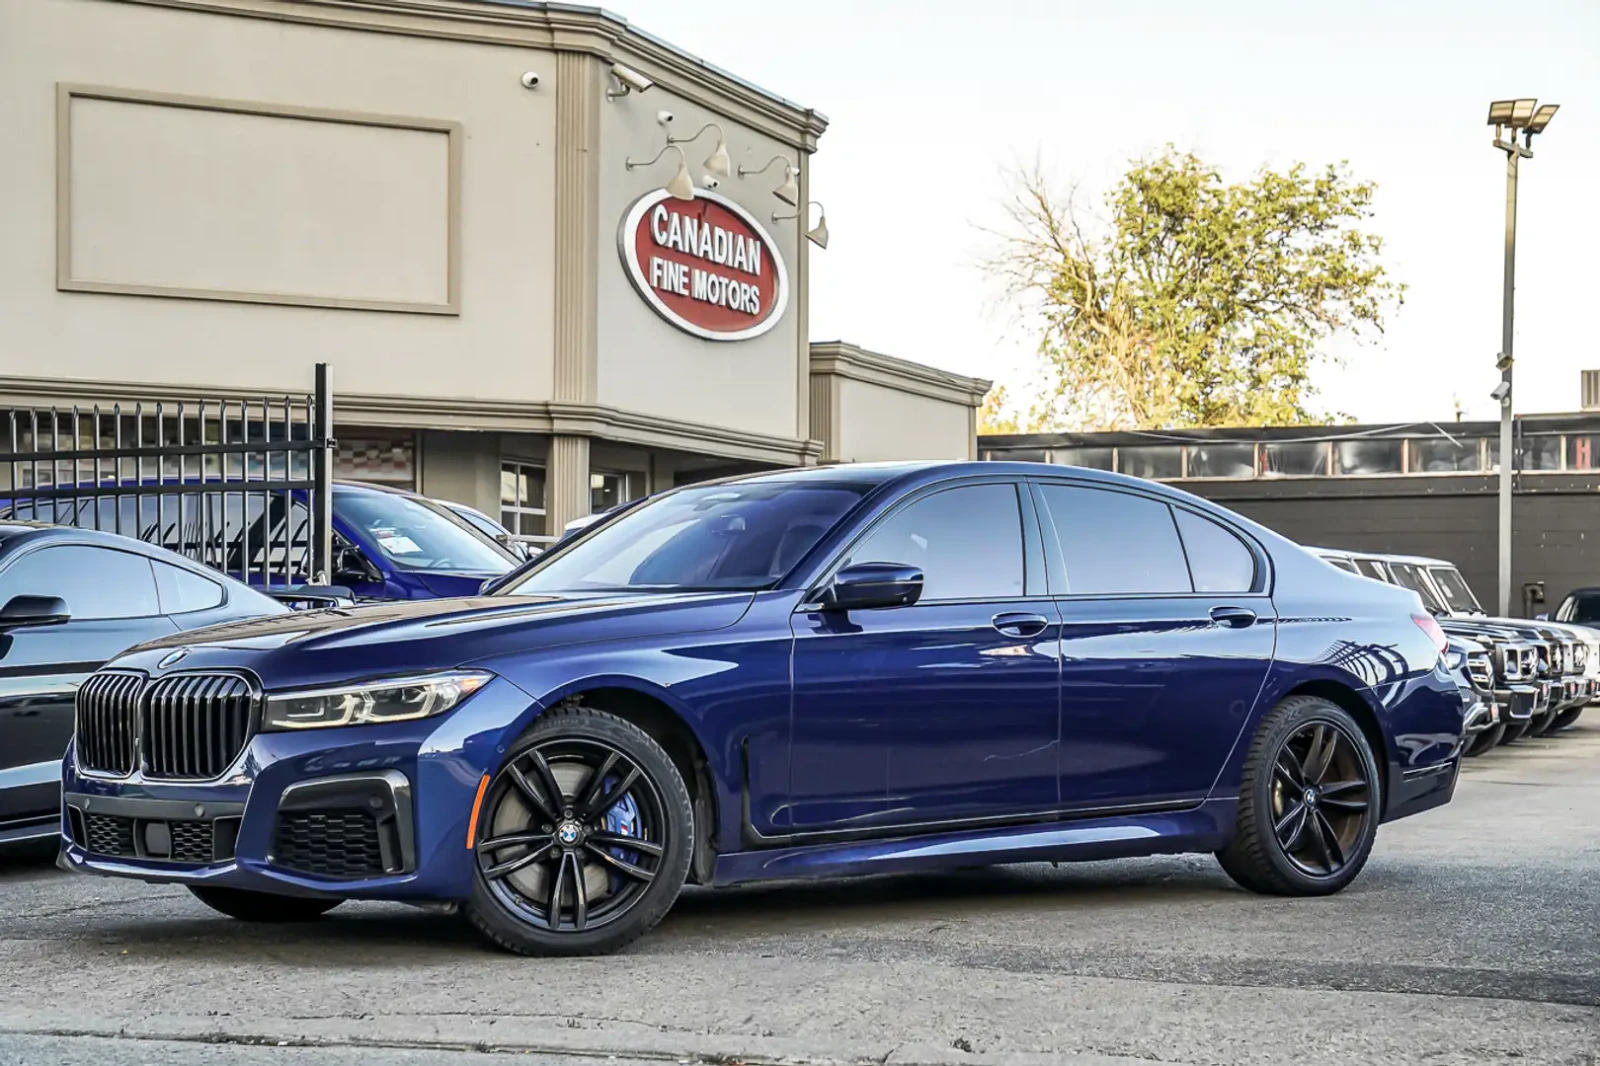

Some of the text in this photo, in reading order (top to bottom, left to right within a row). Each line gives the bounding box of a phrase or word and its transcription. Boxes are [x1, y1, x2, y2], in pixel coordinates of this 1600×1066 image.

[652, 204, 761, 276] CANADIAN
[651, 257, 760, 315] FINE MOTORS
